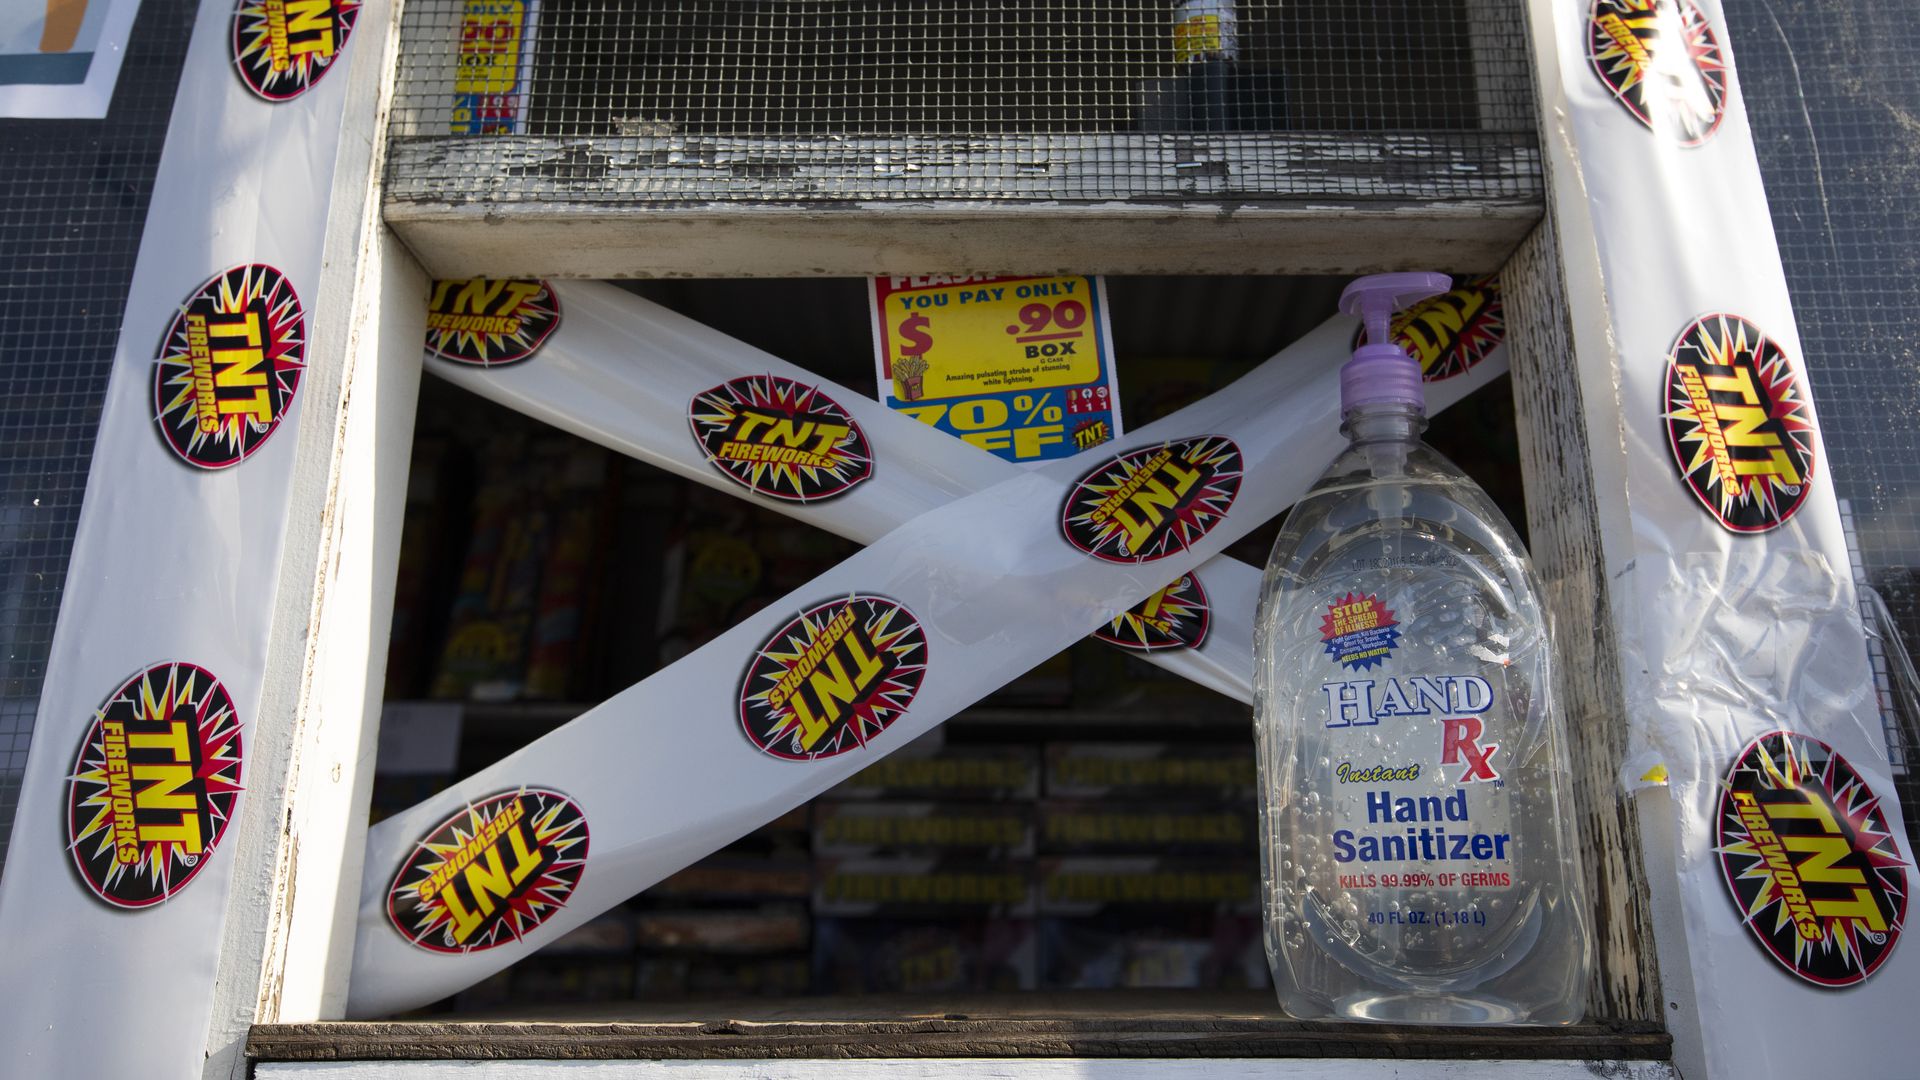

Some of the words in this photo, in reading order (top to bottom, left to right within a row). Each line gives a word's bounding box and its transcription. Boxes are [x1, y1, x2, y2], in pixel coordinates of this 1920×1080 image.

[266, 0, 290, 71] EWORKS
[285, 0, 334, 57] NT
[430, 279, 542, 316] TNT
[899, 293, 949, 310] YOU
[959, 288, 1005, 304] PAY
[1015, 280, 1077, 299] ONLY
[427, 312, 522, 335] REWORKS
[898, 312, 934, 359] $
[1006, 299, 1087, 335] .90
[209, 311, 273, 423] TNT
[1024, 341, 1077, 359] BOX
[187, 313, 220, 434] FIREWORKS
[945, 372, 975, 382] Amazing
[976, 369, 1007, 381] pulsating
[1009, 367, 1031, 376] strobe
[1032, 365, 1040, 373] of
[1041, 363, 1071, 373] stunning
[983, 377, 1002, 386] white
[1003, 375, 1035, 386] lightning.
[734, 409, 850, 456] TNT
[960, 424, 1065, 459] FF
[1075, 420, 1104, 449] TNT
[1677, 364, 1742, 497] FIREWORKS
[1702, 365, 1803, 486] TNT
[718, 441, 837, 469] FIREWORKS
[1091, 449, 1174, 525] FIREWORKS
[1112, 461, 1201, 555] TNT
[1332, 600, 1373, 619] STOP
[1333, 618, 1347, 628] THE
[1348, 611, 1378, 624] SPREAD
[1334, 625, 1344, 636] OF
[1345, 619, 1378, 633] ILLNESS!
[1362, 640, 1388, 650] Workplace
[1370, 627, 1390, 635] Bacteria
[768, 603, 857, 711] FIREWORKS
[1342, 653, 1360, 663] NEEDS
[1359, 651, 1368, 659] NO
[1367, 647, 1389, 657] WATER!
[789, 628, 884, 752] TNT
[1322, 675, 1494, 728] HAND
[127, 720, 203, 855] TNT
[1336, 762, 1420, 784] Instant
[103, 720, 141, 866] FIREWORKS
[1366, 789, 1469, 823] Hand
[418, 797, 525, 903] FIREWORKS
[1332, 827, 1511, 863] Sanitizer
[1762, 786, 1889, 932] TNT
[440, 824, 544, 945] TNT
[1339, 874, 1377, 888] KILLS
[1381, 873, 1435, 888] 99.99%
[1438, 873, 1457, 887] OF
[1461, 872, 1511, 887] GERMS
[1732, 790, 1825, 943] FIREWORKS
[1368, 912, 1385, 924] 40
[1389, 911, 1405, 924] FL
[1409, 911, 1431, 924] OZ.
[1434, 911, 1469, 927] (1.18
[1473, 911, 1486, 927] L)
